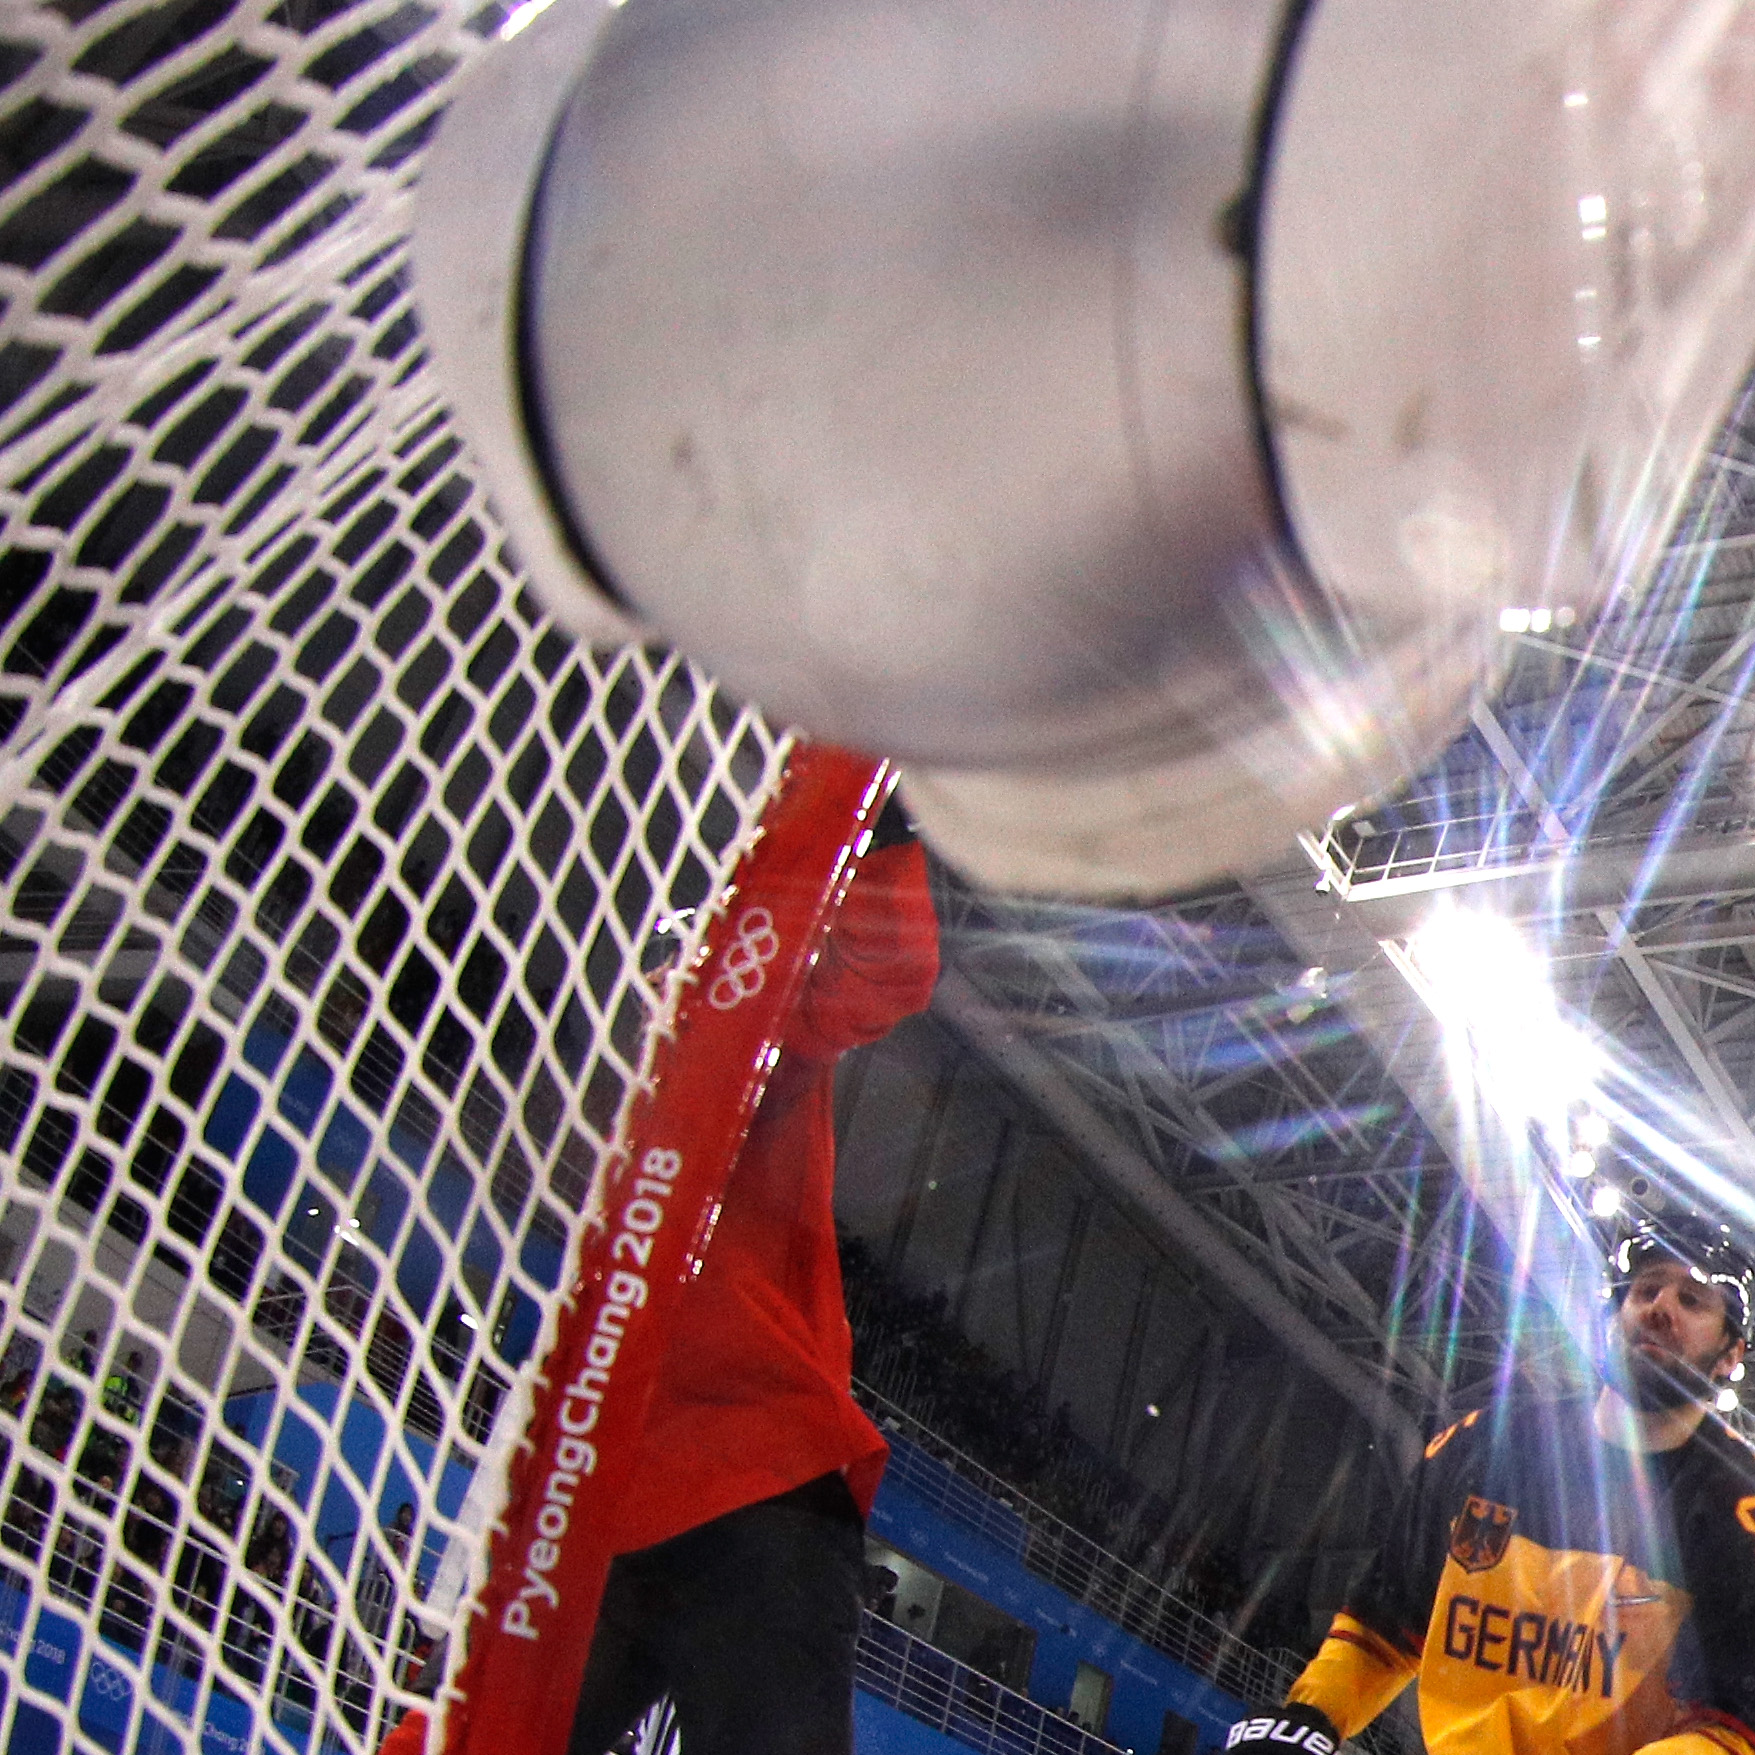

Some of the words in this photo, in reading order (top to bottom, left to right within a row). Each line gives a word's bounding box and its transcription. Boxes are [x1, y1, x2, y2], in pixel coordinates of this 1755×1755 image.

[502, 1268, 649, 1641] PyeongChang
[612, 1145, 684, 1268] 2018
[1443, 1592, 1628, 1700] GERMANY
